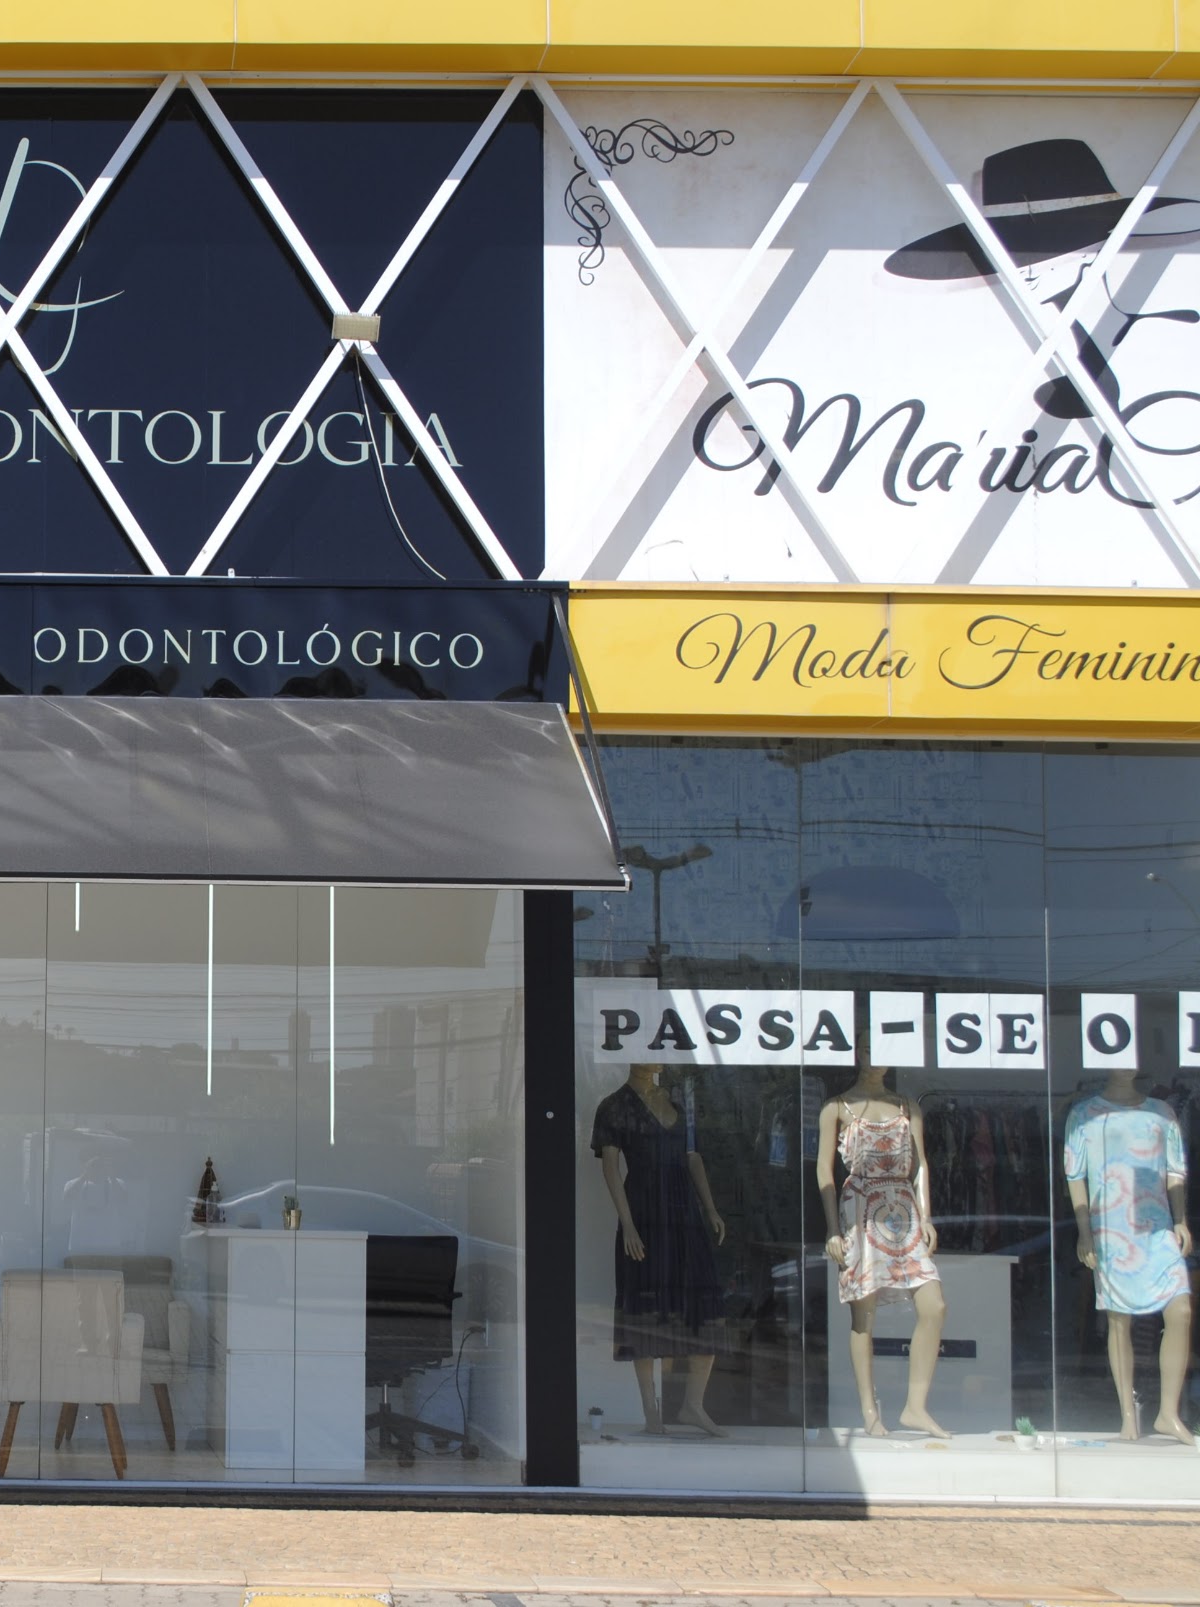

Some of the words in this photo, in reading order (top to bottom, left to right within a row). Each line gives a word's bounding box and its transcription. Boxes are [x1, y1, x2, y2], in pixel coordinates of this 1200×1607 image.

[33, 623, 484, 670] ODONTOLÓGICO
[675, 613, 916, 688] Moda
[1086, 1013, 1131, 1055] O
